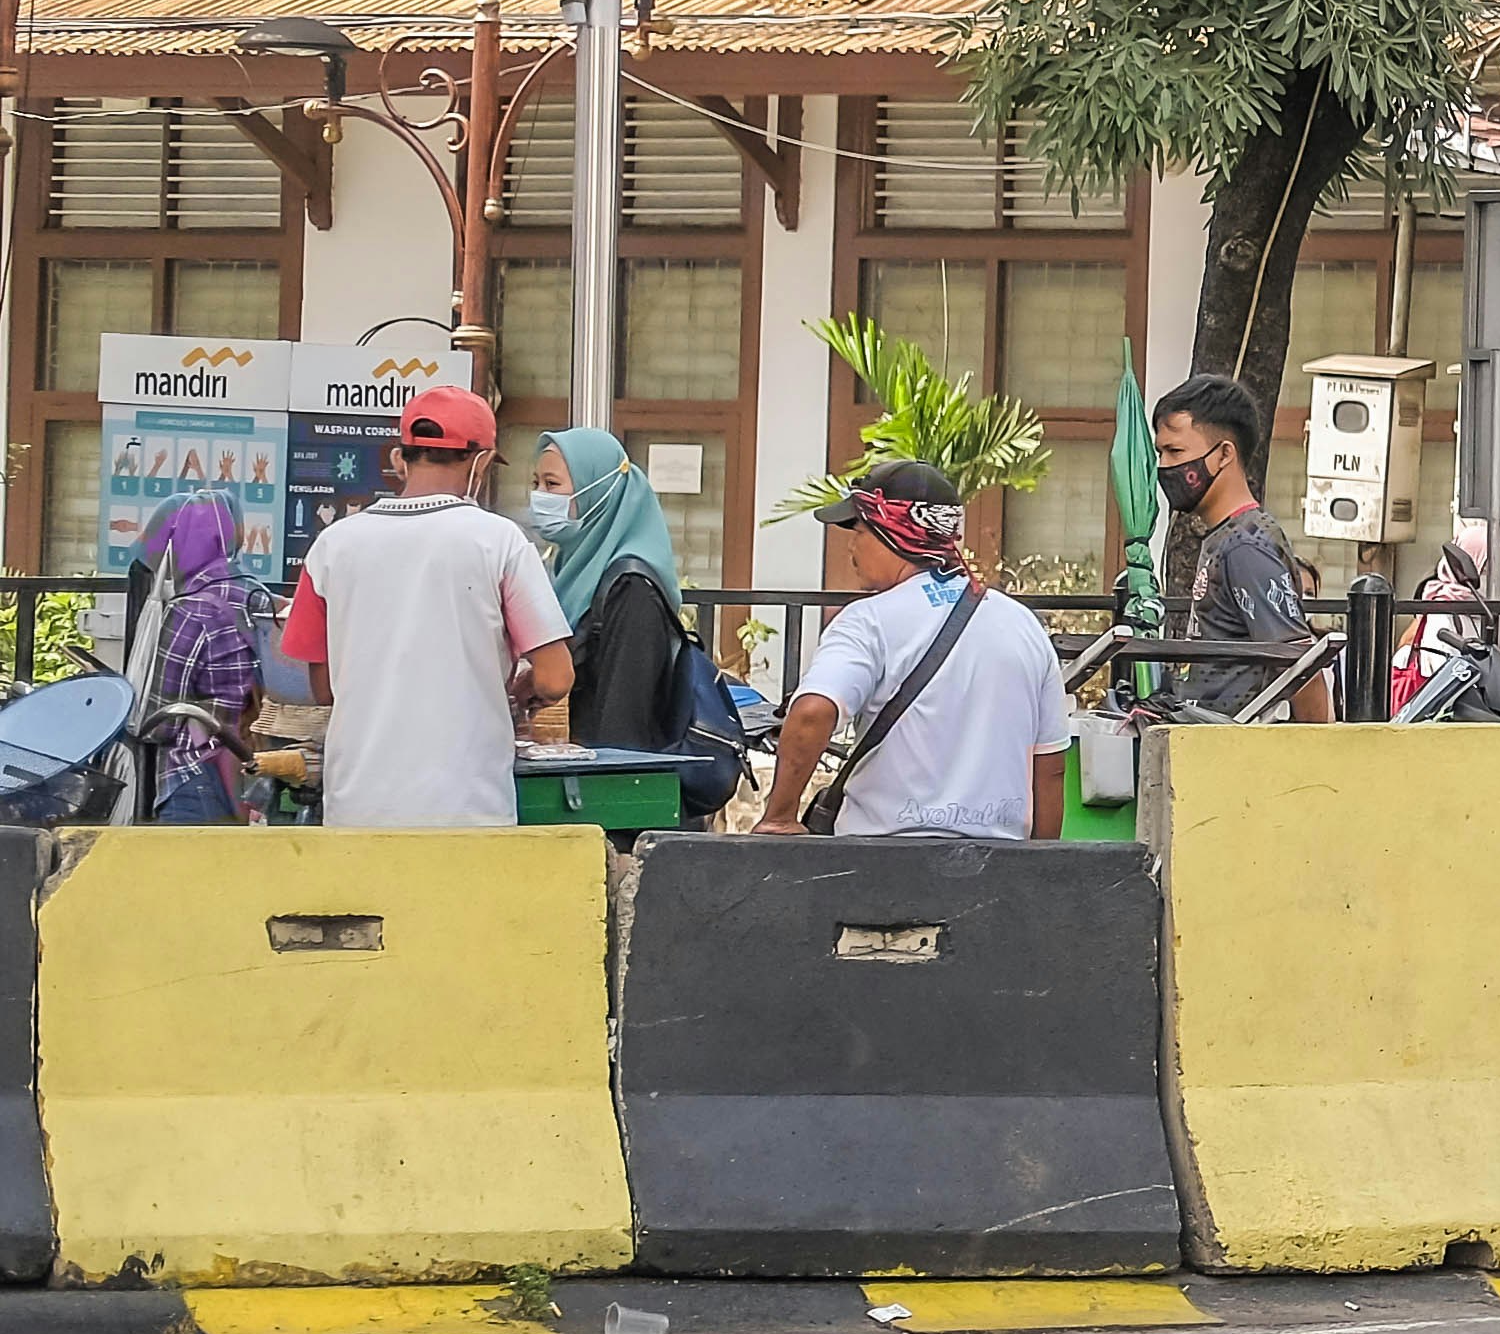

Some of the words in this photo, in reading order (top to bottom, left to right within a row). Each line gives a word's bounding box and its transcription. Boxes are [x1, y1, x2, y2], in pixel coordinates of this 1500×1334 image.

[135, 366, 228, 399] mandiri
[314, 424, 362, 436] WASPADA
[1333, 454, 1361, 472] PLN
